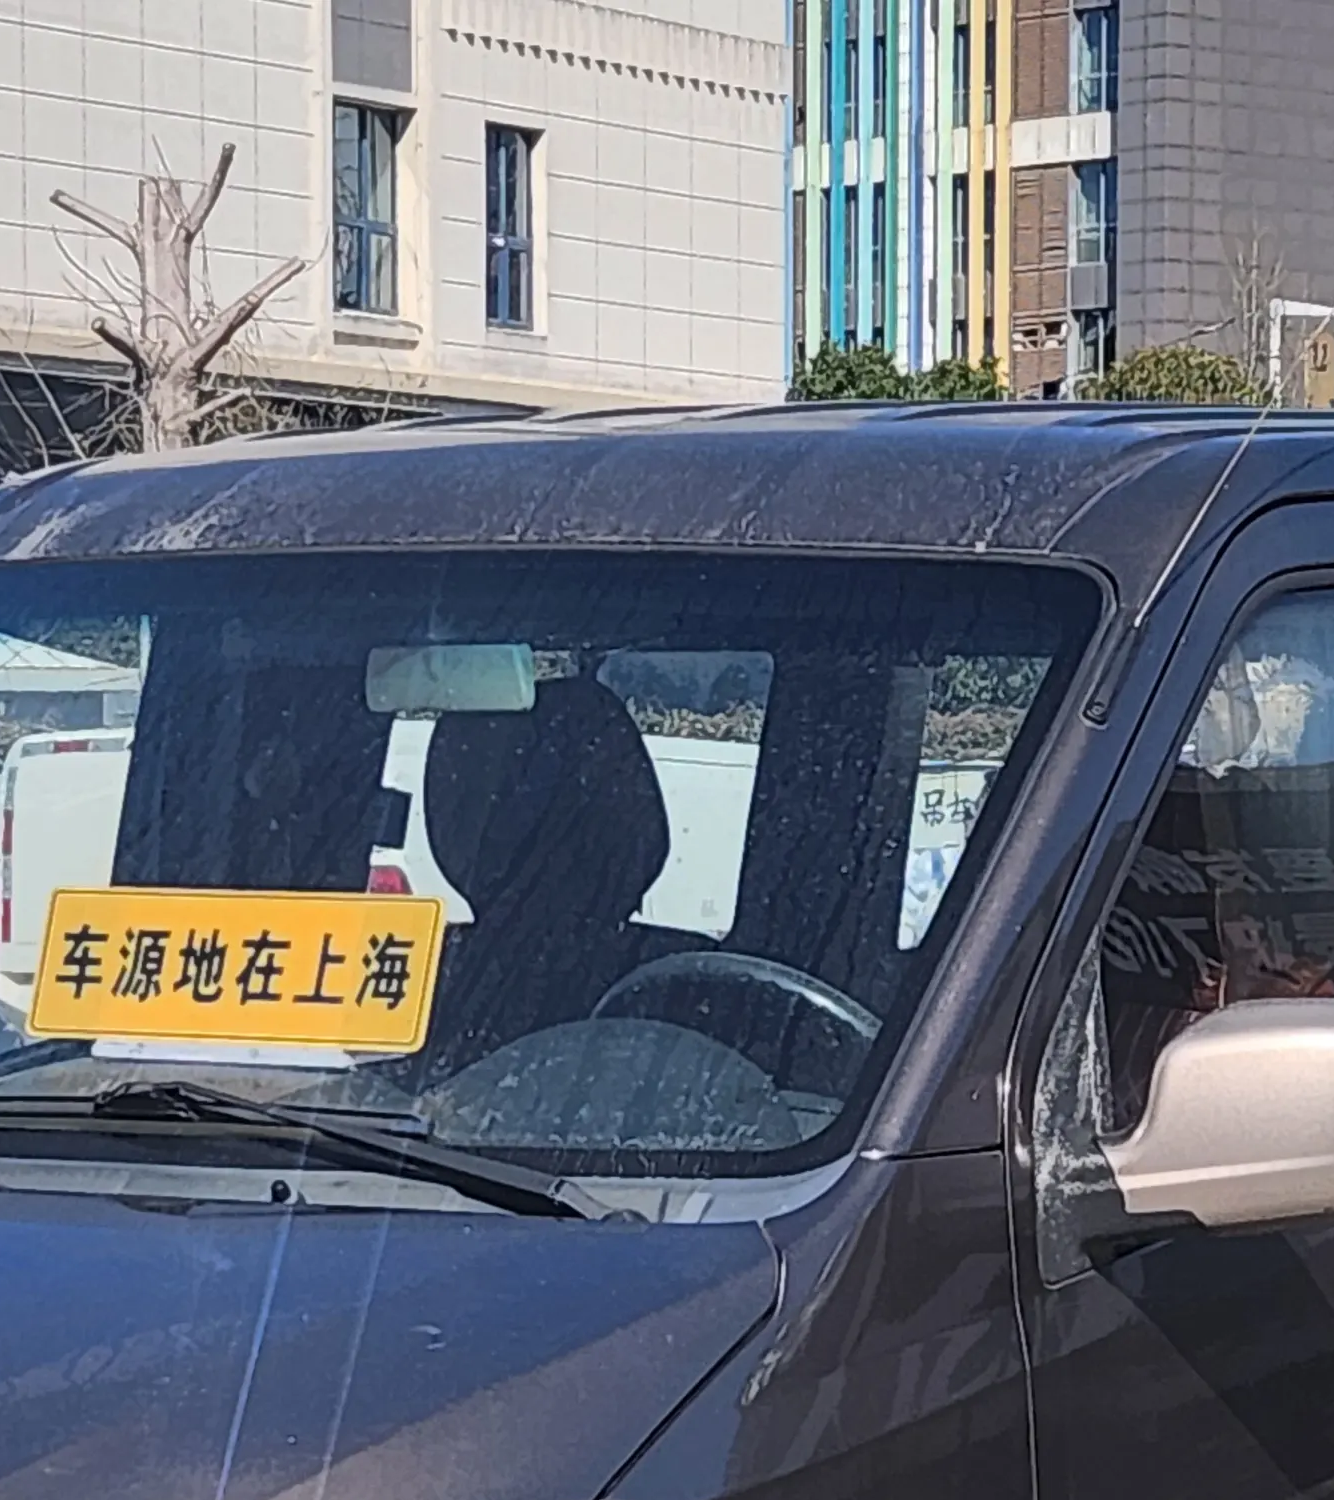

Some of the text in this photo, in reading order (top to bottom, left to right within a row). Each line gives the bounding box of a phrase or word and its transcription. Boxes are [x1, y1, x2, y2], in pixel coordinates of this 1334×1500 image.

[55, 924, 415, 1010] 车源地在上海
